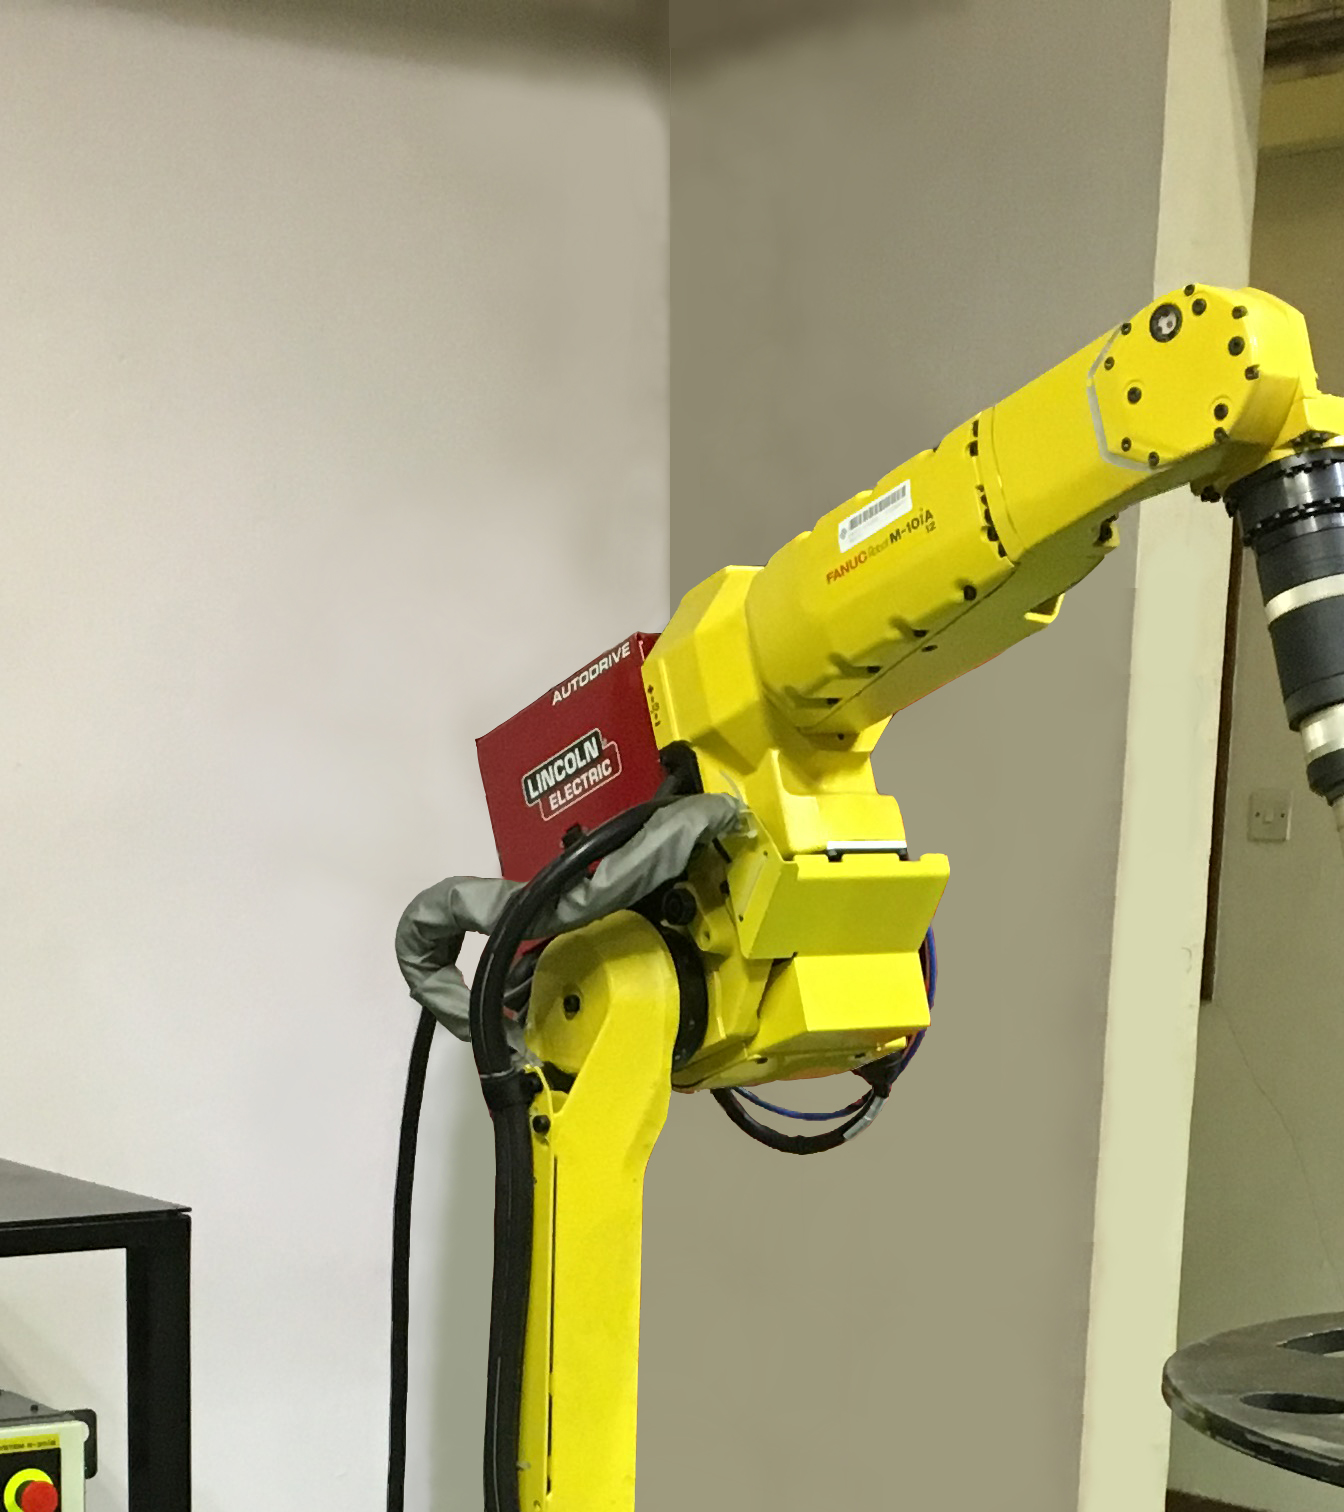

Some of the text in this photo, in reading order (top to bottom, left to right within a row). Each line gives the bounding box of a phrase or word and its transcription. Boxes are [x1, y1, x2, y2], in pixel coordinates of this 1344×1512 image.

[826, 551, 868, 584] FANUC
[552, 641, 631, 706] AUTODRIVE
[527, 736, 600, 799] LINCOLN
[549, 758, 612, 811] ELECTRIC
